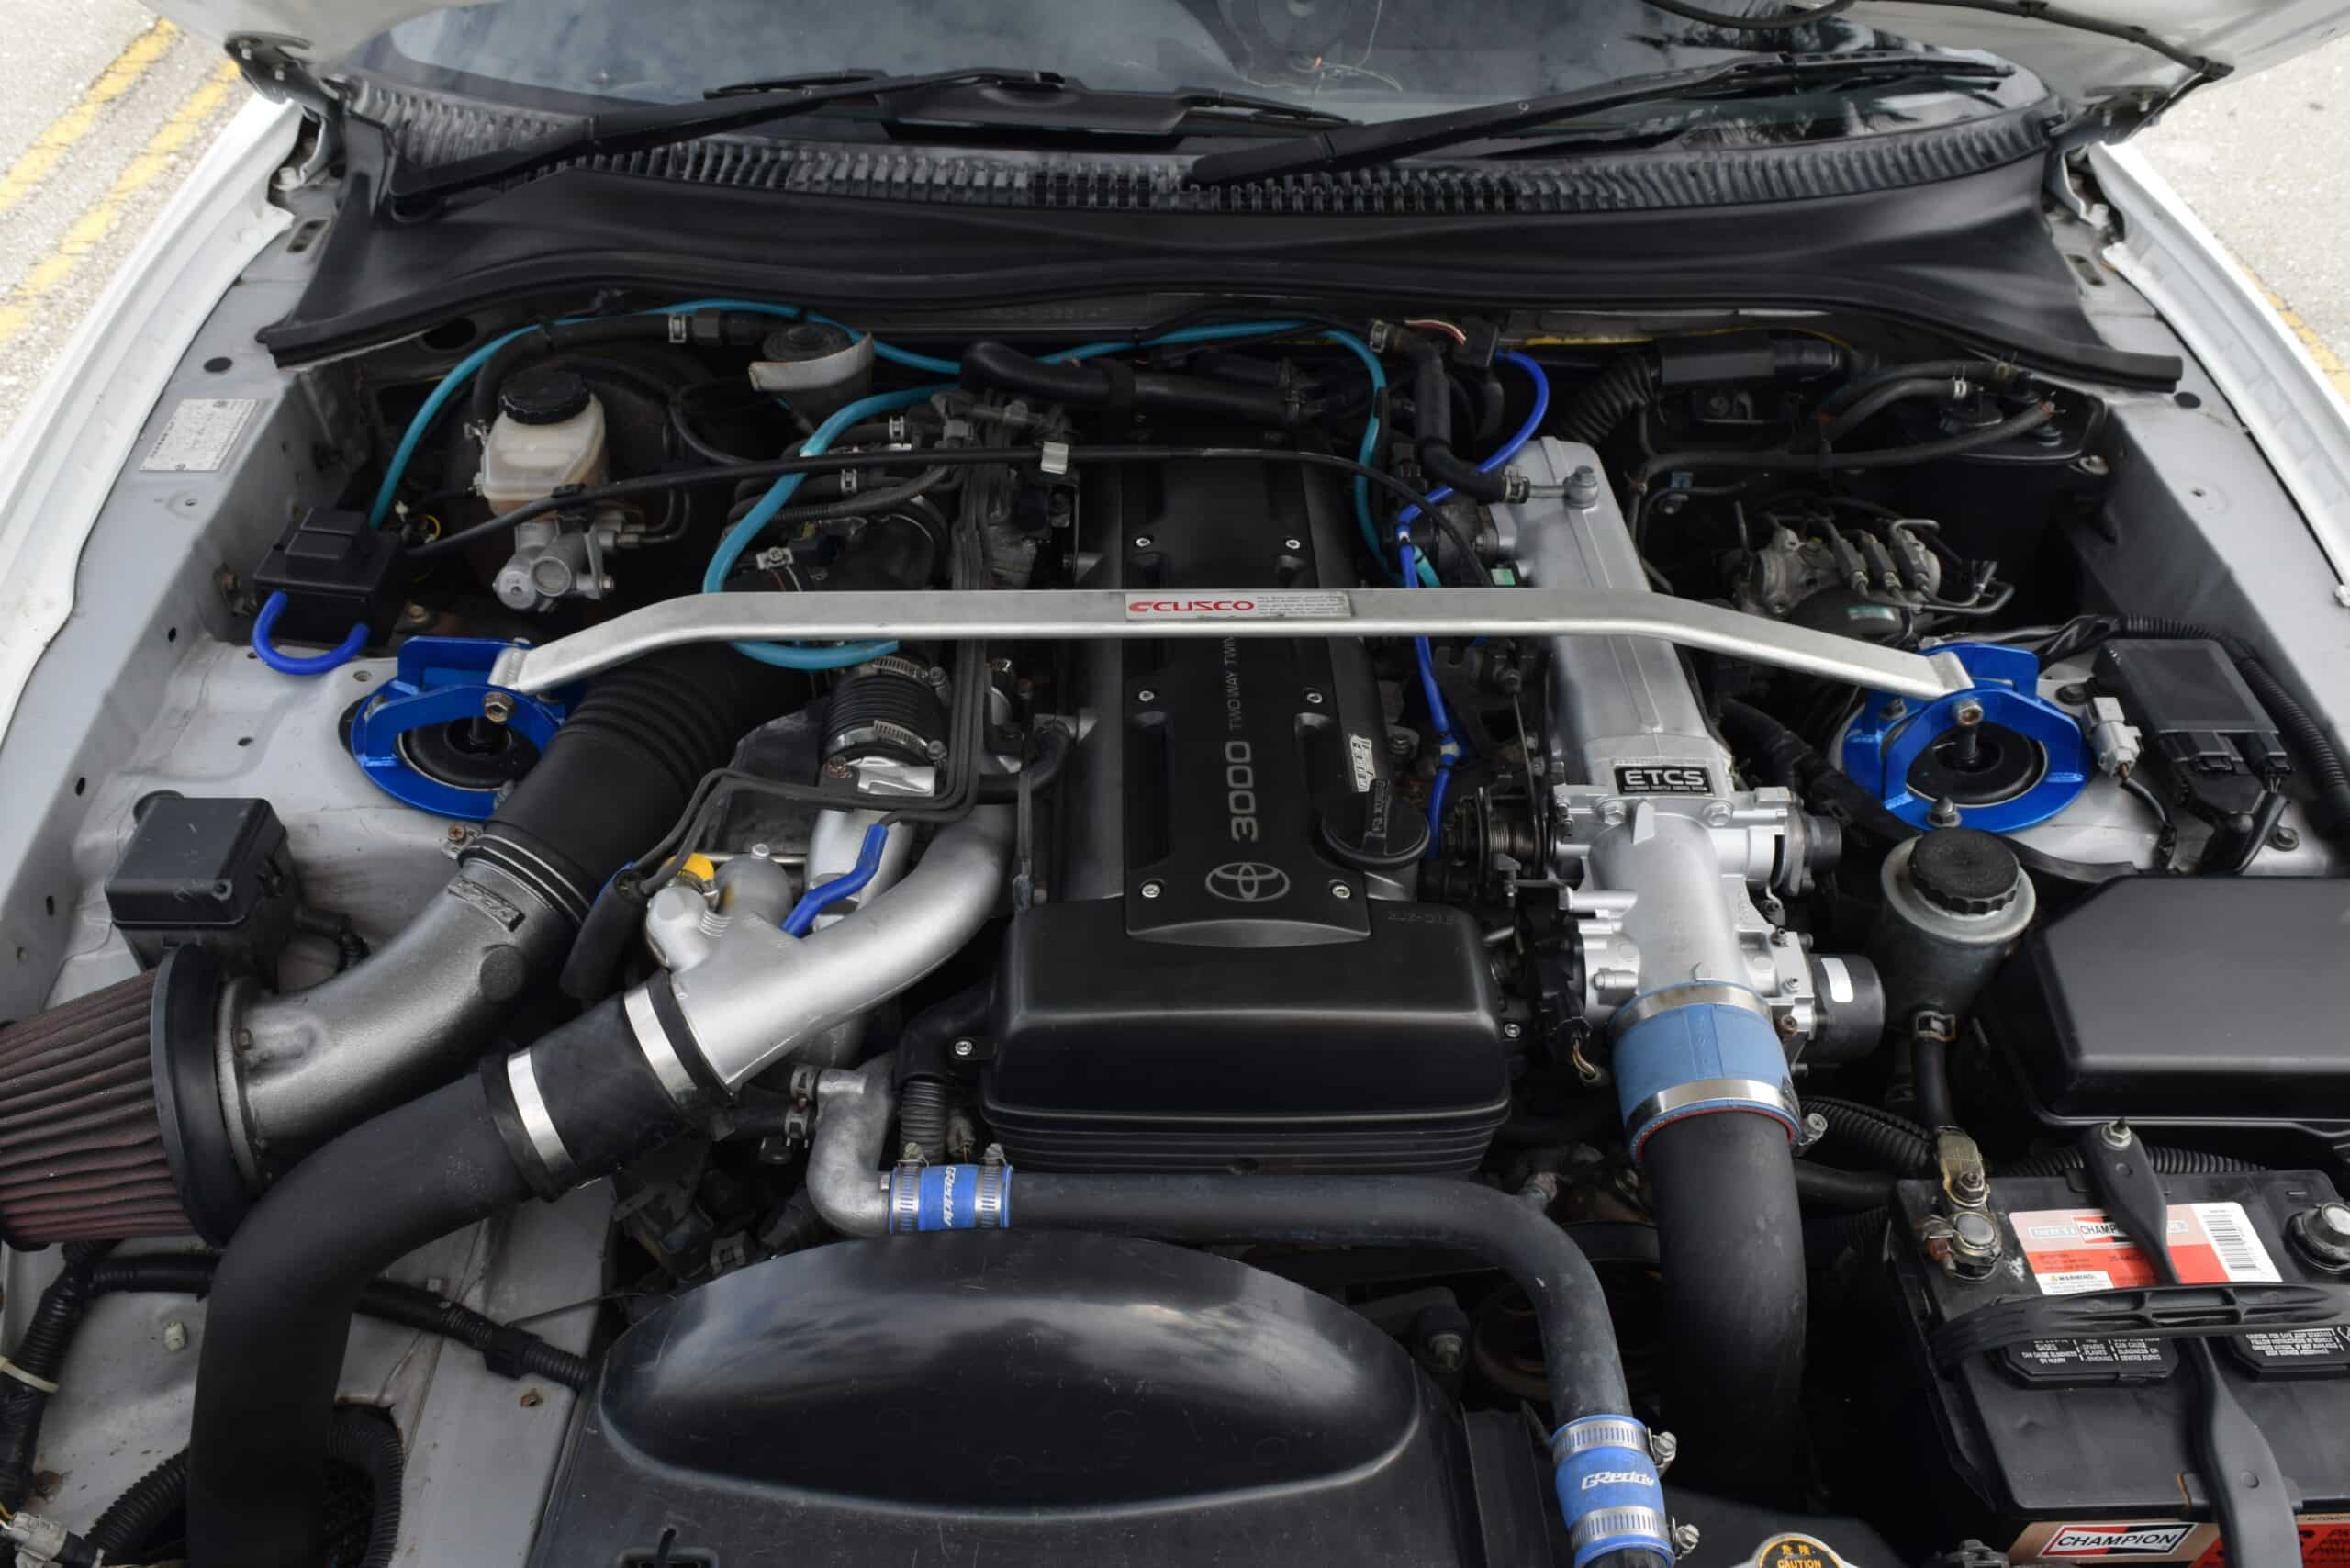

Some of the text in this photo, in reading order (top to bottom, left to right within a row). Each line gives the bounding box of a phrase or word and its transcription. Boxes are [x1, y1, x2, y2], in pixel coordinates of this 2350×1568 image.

[1152, 601, 1254, 611] CUSCO
[1625, 769, 1705, 786] ETCS
[1225, 740, 1259, 843] 3000
[2079, 1224, 2116, 1236] CHAMP
[1581, 1471, 1654, 1491] GReddy
[2058, 1533, 2179, 1547] CHAMPION
[1777, 1559, 1822, 1568] CAUTION
